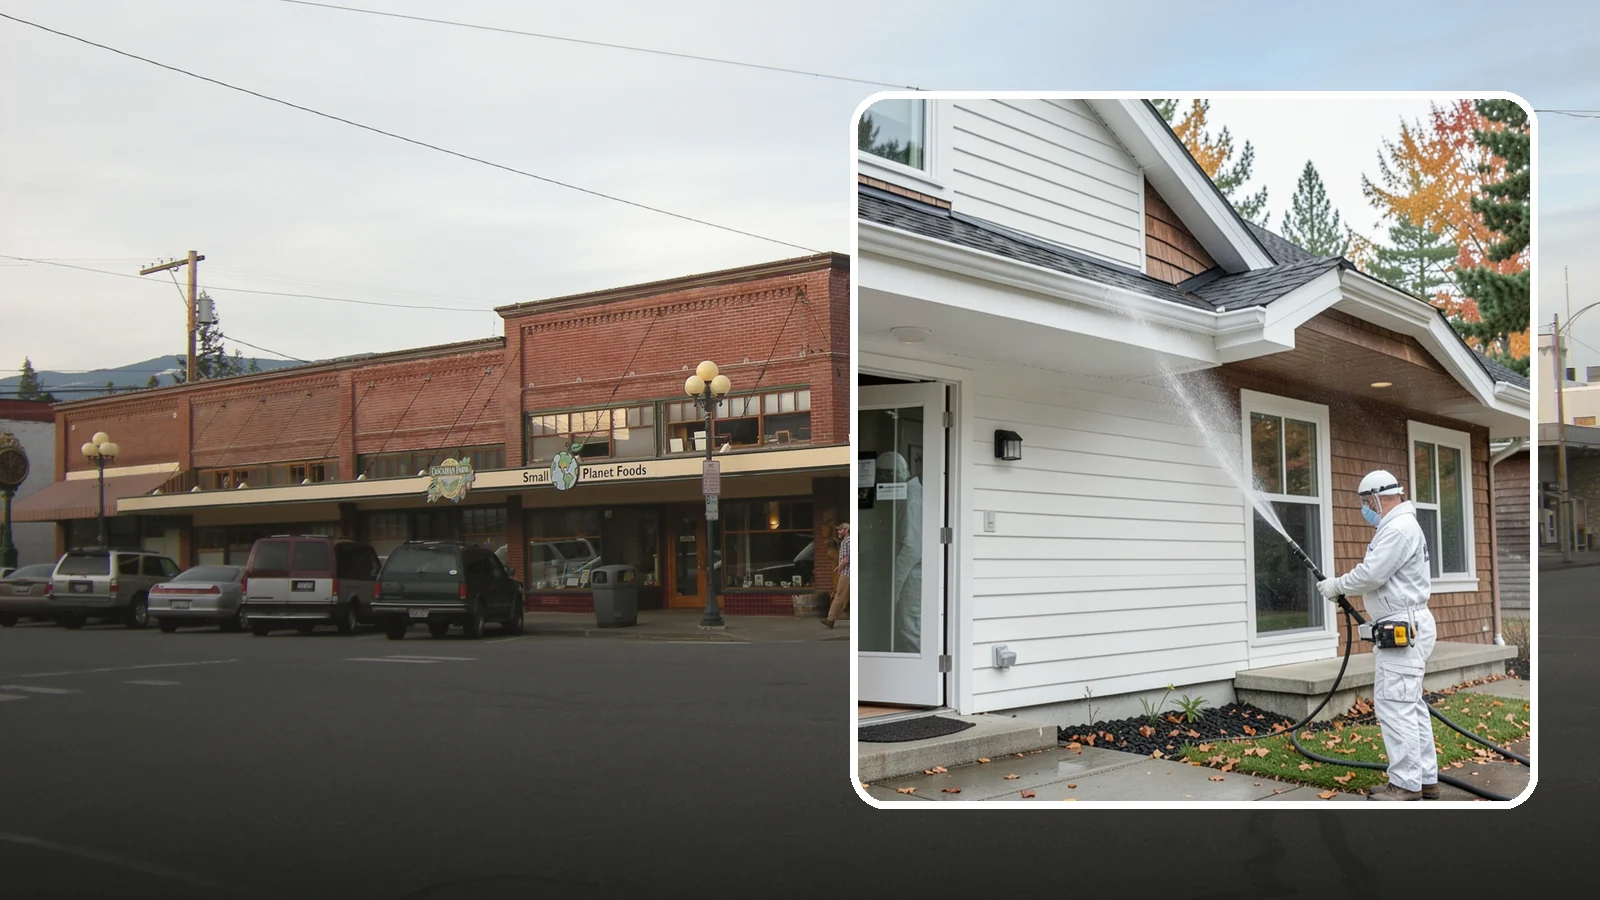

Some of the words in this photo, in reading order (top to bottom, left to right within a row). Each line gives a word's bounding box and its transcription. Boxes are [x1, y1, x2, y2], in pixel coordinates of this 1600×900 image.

[523, 470, 549, 483] Small
[583, 467, 614, 479] Planet
[617, 464, 647, 477] Foods
